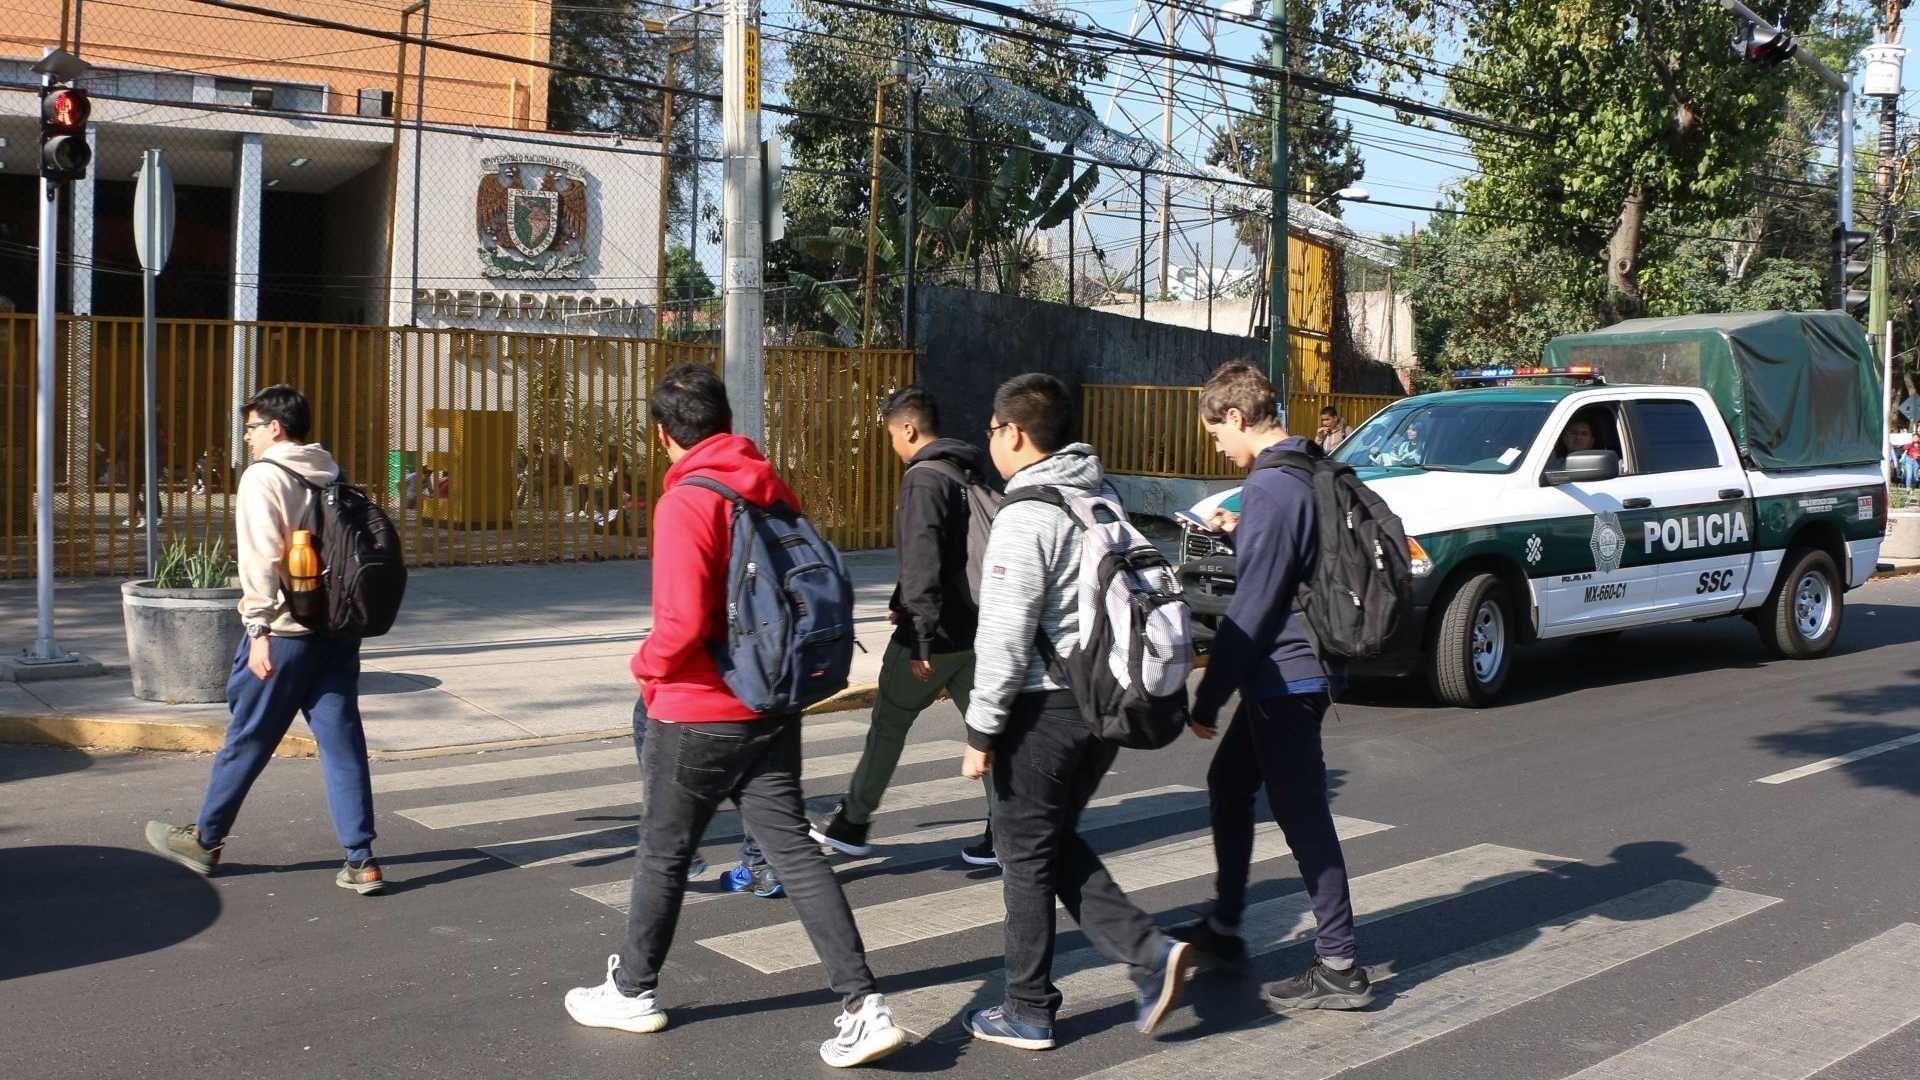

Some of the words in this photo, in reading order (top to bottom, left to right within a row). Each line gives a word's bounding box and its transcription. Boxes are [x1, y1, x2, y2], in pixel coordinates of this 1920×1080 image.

[747, 31, 756, 110] D9683
[415, 289, 644, 324] PREPARATORIA
[1644, 512, 1748, 553] POLICIA
[1584, 582, 1627, 604] MX-660-C1
[1696, 569, 1734, 594] SSC
